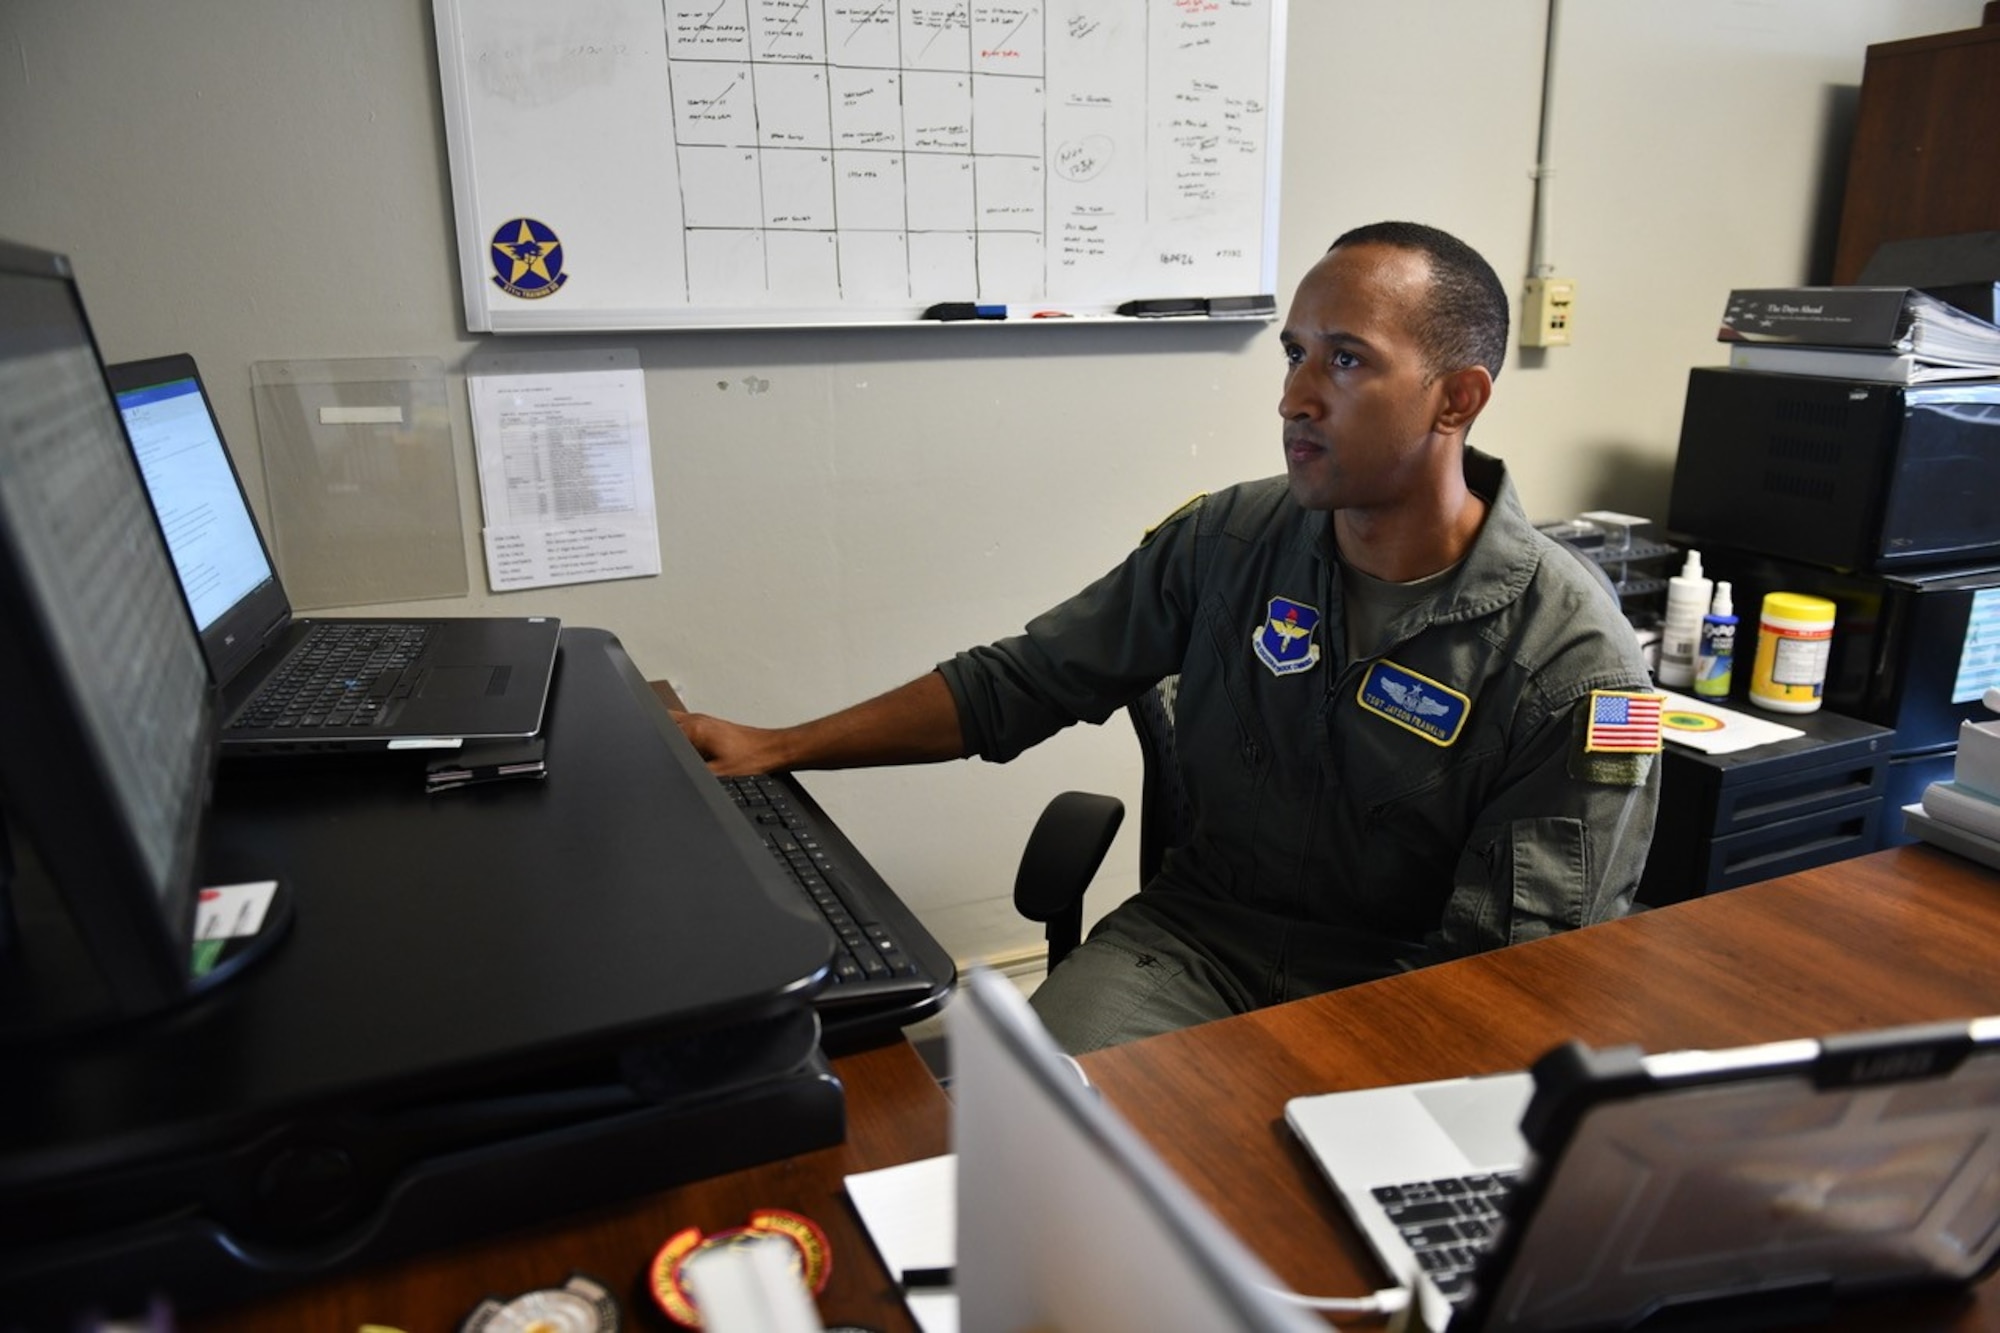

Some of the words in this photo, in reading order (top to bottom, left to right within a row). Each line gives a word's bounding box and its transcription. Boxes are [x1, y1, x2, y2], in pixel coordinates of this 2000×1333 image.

[1767, 303, 1781, 313] The
[1782, 304, 1800, 314] Days
[1801, 305, 1824, 314] Ahead
[1411, 715, 1446, 739] FRANKLIN
